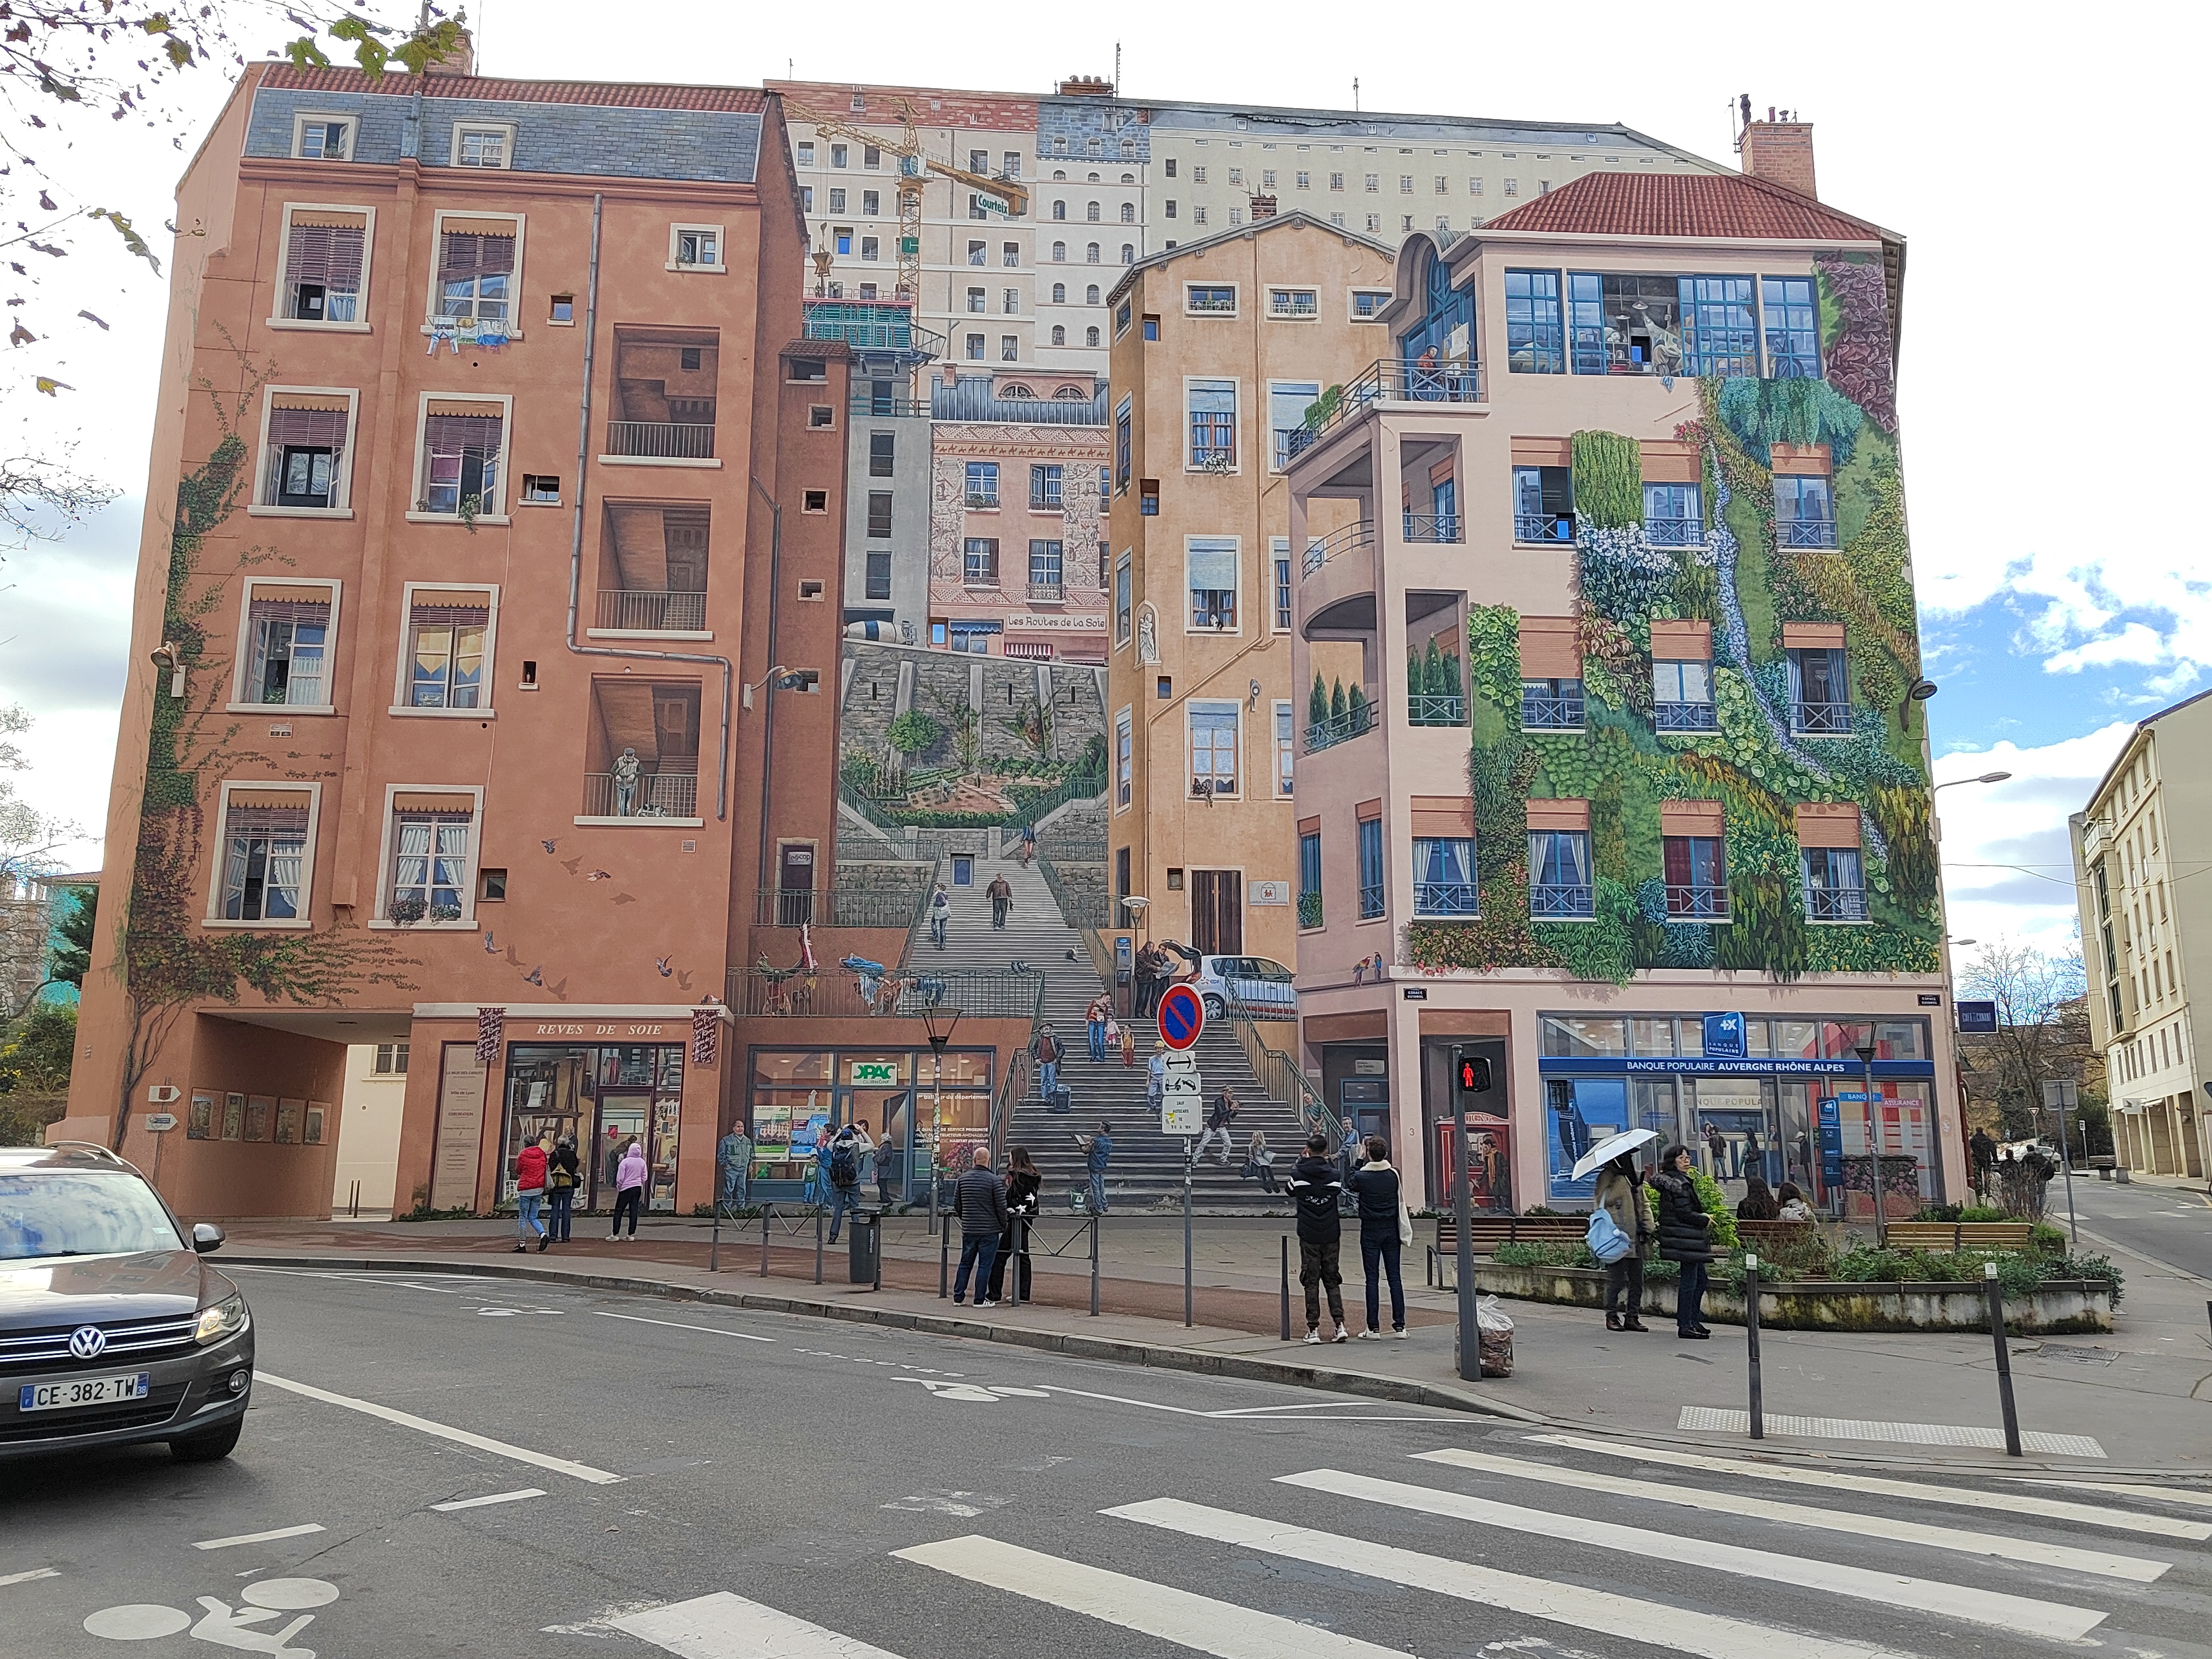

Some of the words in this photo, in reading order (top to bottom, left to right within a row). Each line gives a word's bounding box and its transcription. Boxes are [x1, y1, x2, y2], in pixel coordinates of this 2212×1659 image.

[978, 194, 1007, 215] Courteix
[1008, 616, 1024, 626] Les
[1026, 616, 1058, 627] Routes
[1061, 618, 1071, 627] de
[1086, 618, 1105, 628] Soie
[537, 1024, 583, 1035] REVES
[595, 1025, 616, 1035] DE
[628, 1025, 662, 1035] SOIE
[1627, 1062, 1666, 1070] BANQUE
[1718, 1062, 1773, 1071] AUVERGNE
[1775, 1061, 1812, 1071] RHÔNE
[1813, 1064, 1845, 1072] ALPES
[1409, 1128, 1415, 1136] 3
[37, 1379, 135, 1406] CE-382-TW
[137, 1385, 147, 1395] 38
